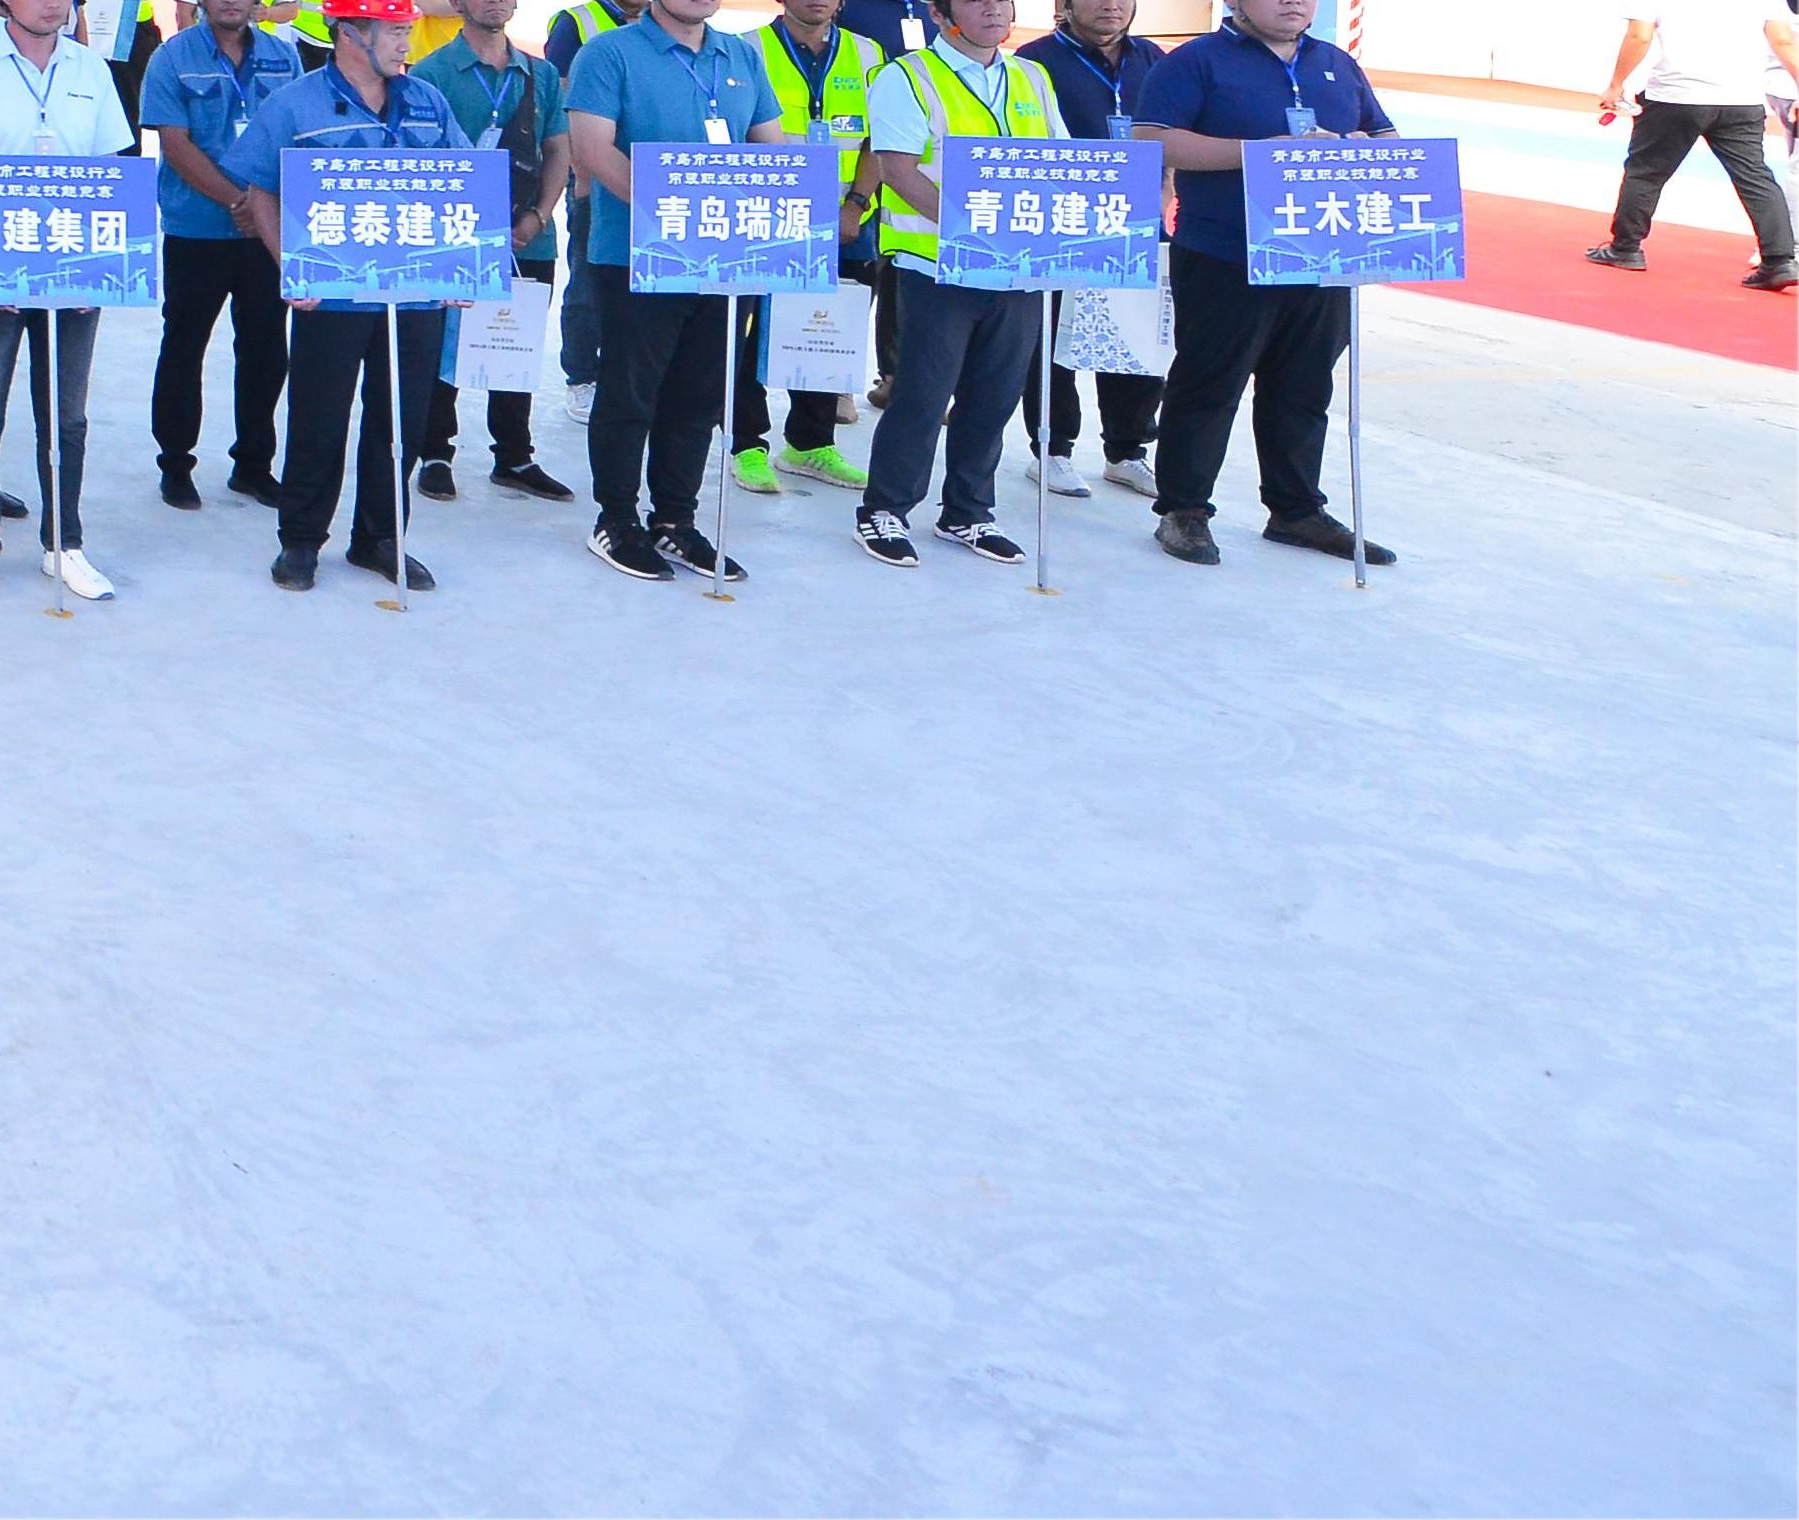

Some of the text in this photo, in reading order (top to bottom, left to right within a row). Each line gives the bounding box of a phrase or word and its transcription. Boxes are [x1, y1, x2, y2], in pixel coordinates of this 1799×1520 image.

[311, 158, 473, 173] 青岛市工程建设行业
[660, 152, 807, 167] 青岛市工程建设行业
[970, 146, 1127, 163] 青岛市工程建设行业
[1272, 148, 1426, 164] 青岛市工程建设行业
[307, 201, 480, 246] 德泰建设
[655, 195, 811, 240] 青岛瑞源
[966, 190, 1132, 235] 青岛建设
[1274, 192, 1435, 236] 土木建工
